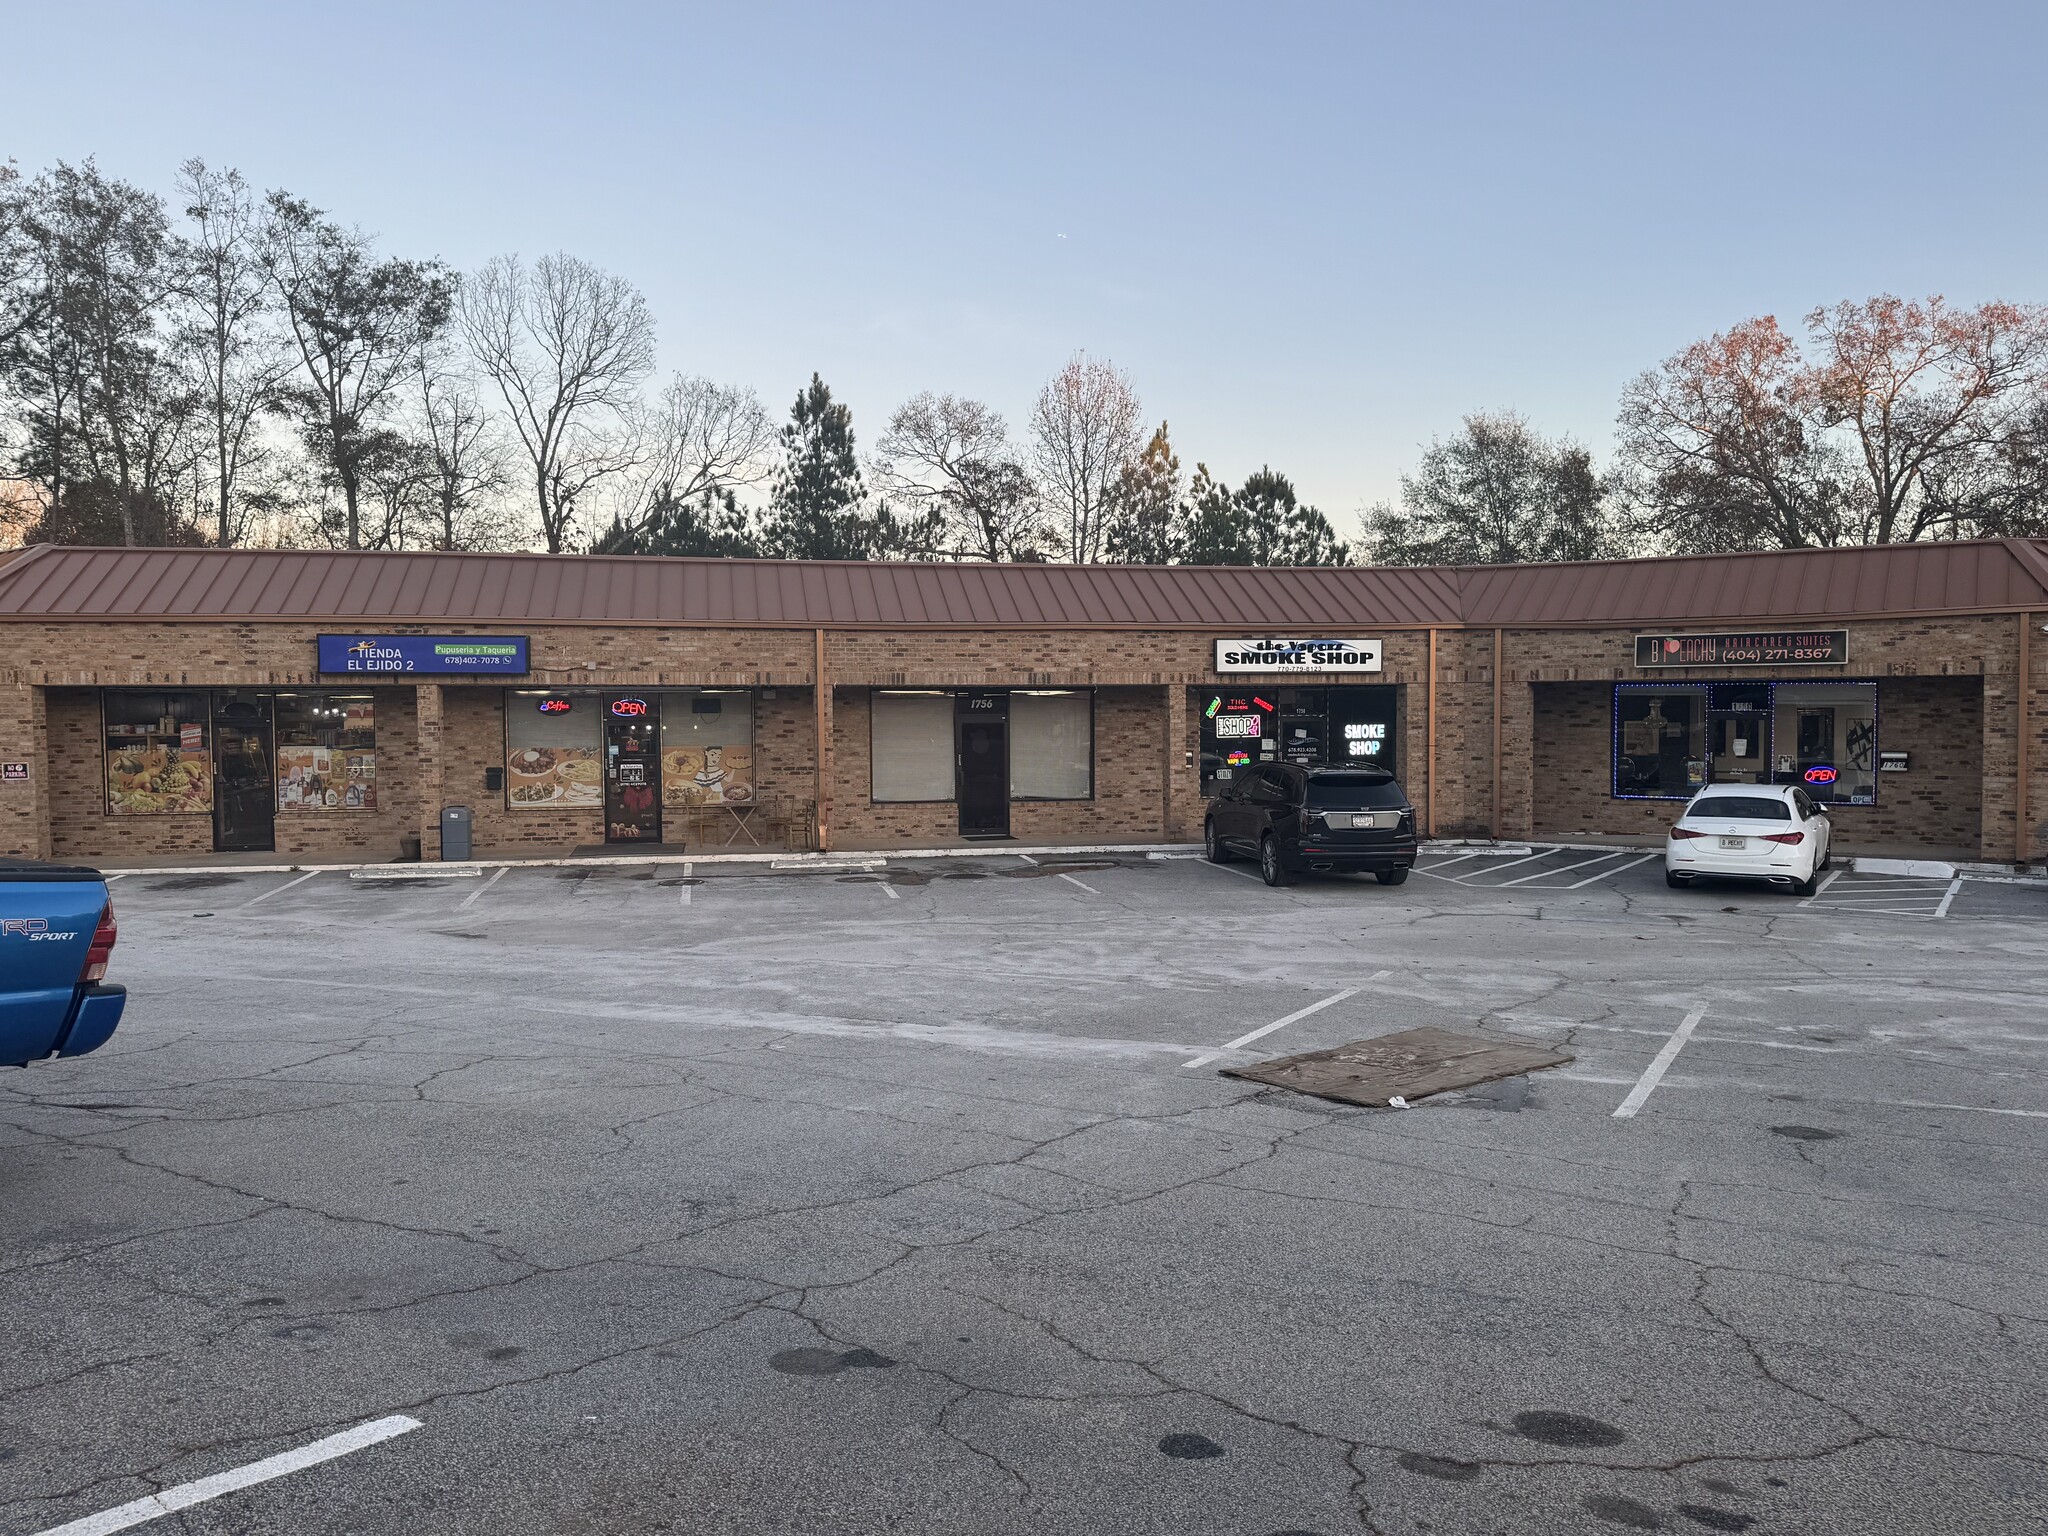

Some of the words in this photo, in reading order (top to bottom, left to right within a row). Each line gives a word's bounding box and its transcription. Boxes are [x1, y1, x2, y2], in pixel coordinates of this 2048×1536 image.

[1256, 640, 1284, 651] the
[1725, 637, 1751, 648] HAIR
[1755, 636, 1782, 647] CARE
[1796, 635, 1831, 646] SUITES
[359, 648, 402, 658] TIENDA
[1651, 639, 1659, 663] B
[1722, 649, 1761, 662] (404)
[1765, 648, 1832, 660] 271-8367
[444, 657, 500, 665] 678)402-7078
[1224, 652, 1306, 665] SMOKE
[1311, 652, 1374, 665] SHOP
[347, 660, 363, 670] EL
[367, 660, 402, 670] EJIDO
[406, 660, 414, 671] 2
[547, 700, 570, 711] Coffee
[612, 701, 646, 715] OPEN
[971, 699, 993, 709] 1756
[1224, 717, 1251, 735] SHOP
[1344, 724, 1385, 739] SMOKE
[1349, 740, 1380, 756] SHOP
[1804, 769, 1837, 781] OPEN
[0, 917, 48, 936] RD
[28, 932, 79, 941] SPORT
